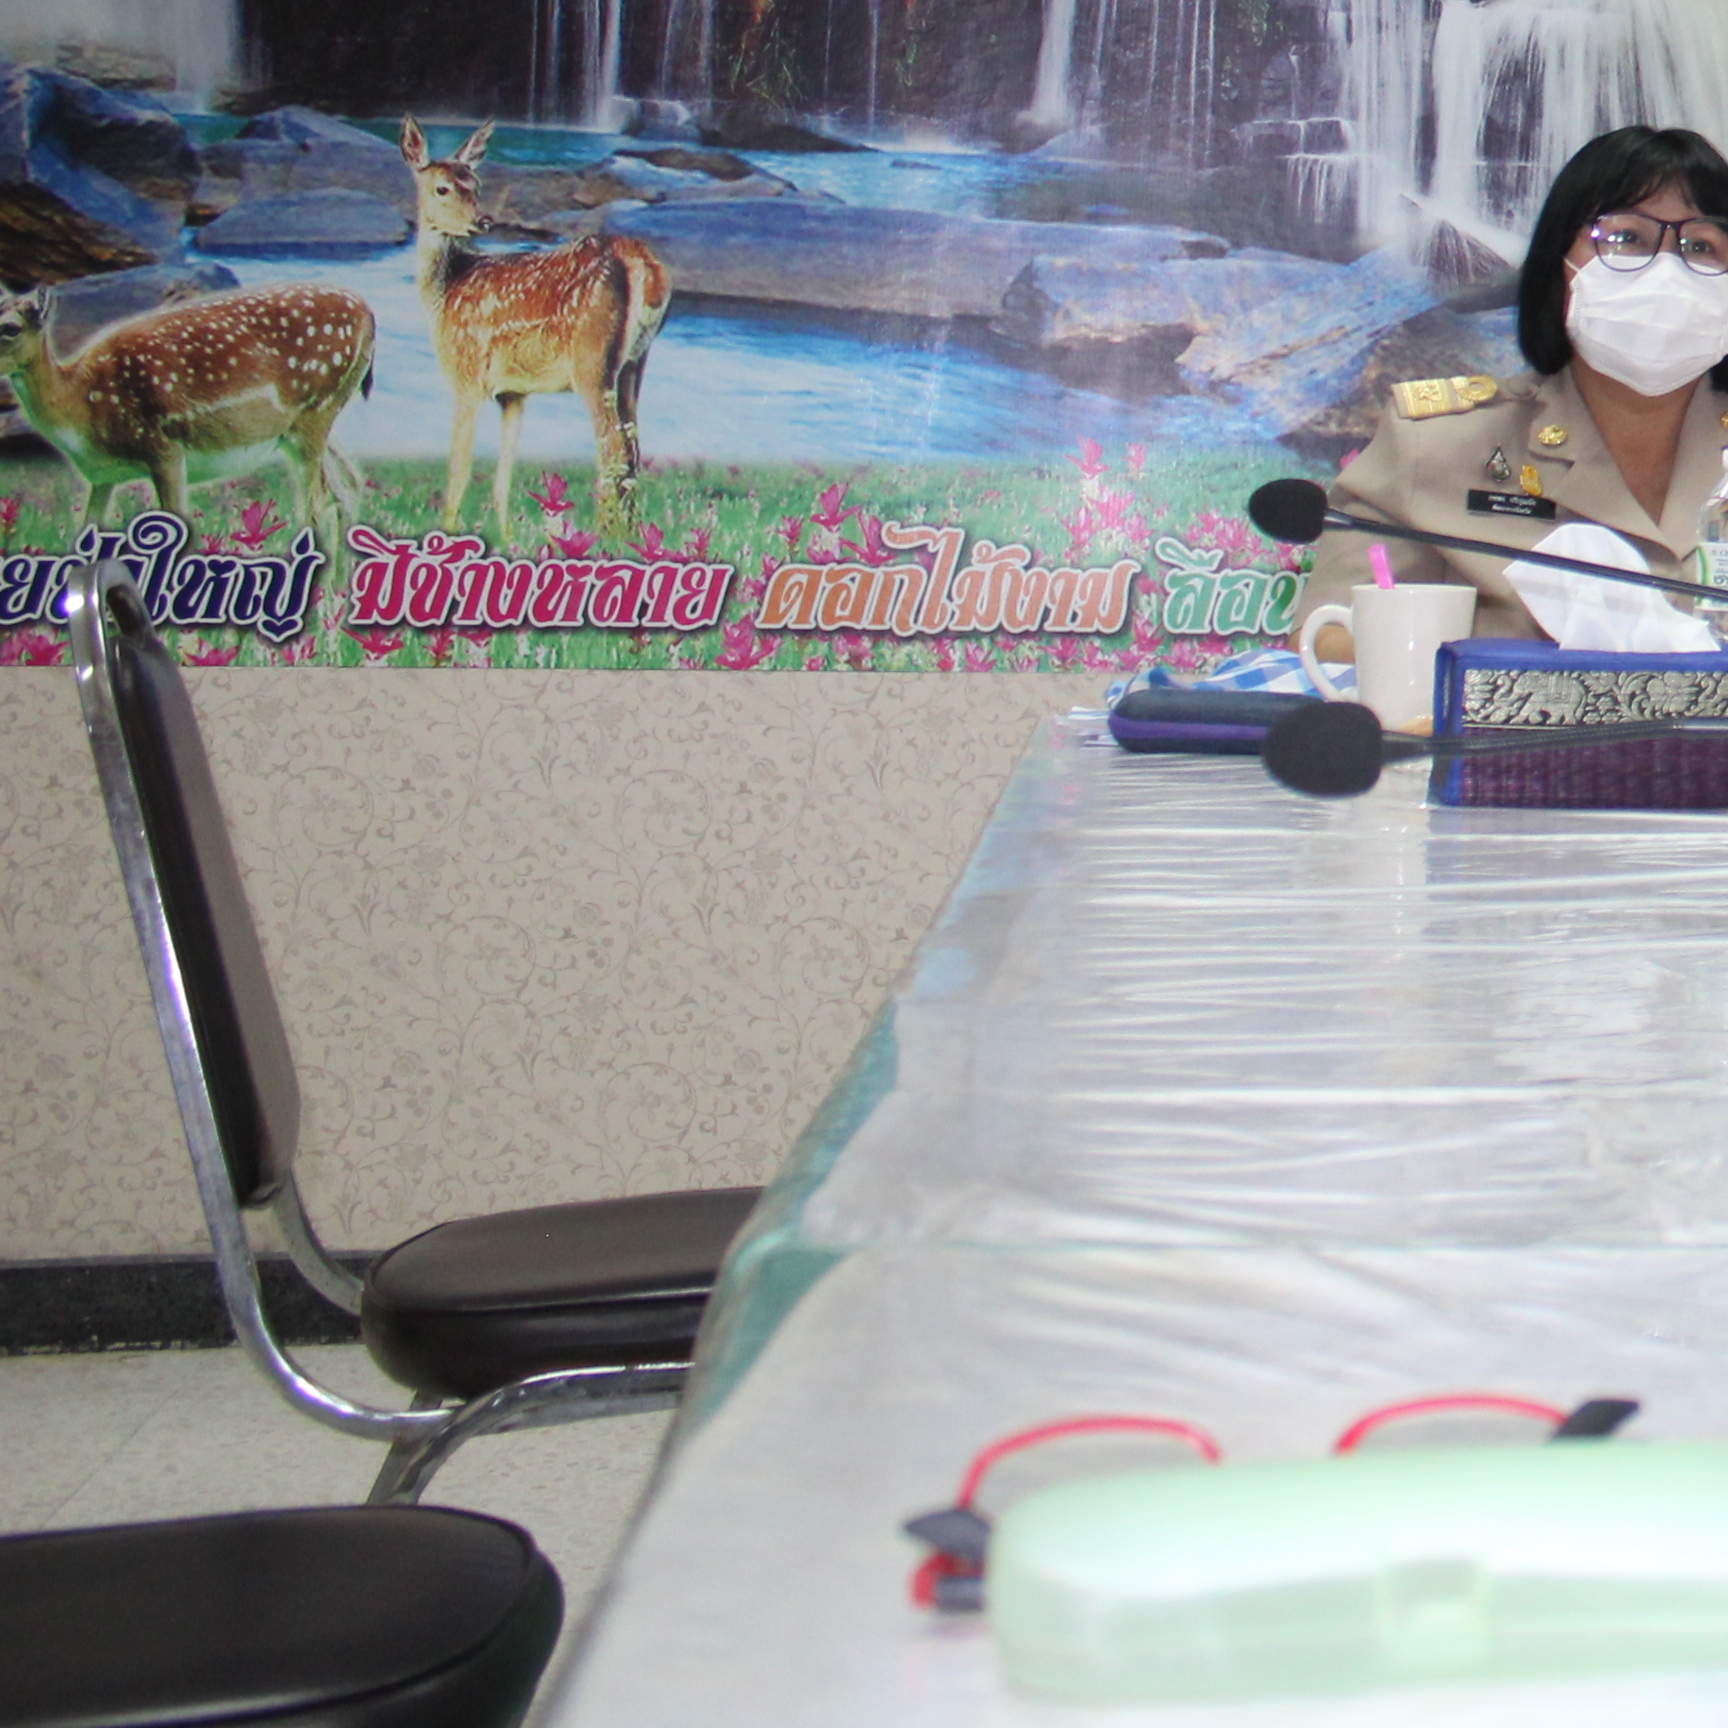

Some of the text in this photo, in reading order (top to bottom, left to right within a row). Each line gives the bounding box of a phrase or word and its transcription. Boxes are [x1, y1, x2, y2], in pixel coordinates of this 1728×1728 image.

[347, 523, 733, 631] มีช้างหลาย
[755, 520, 1142, 637] ดอกไม้งาม
